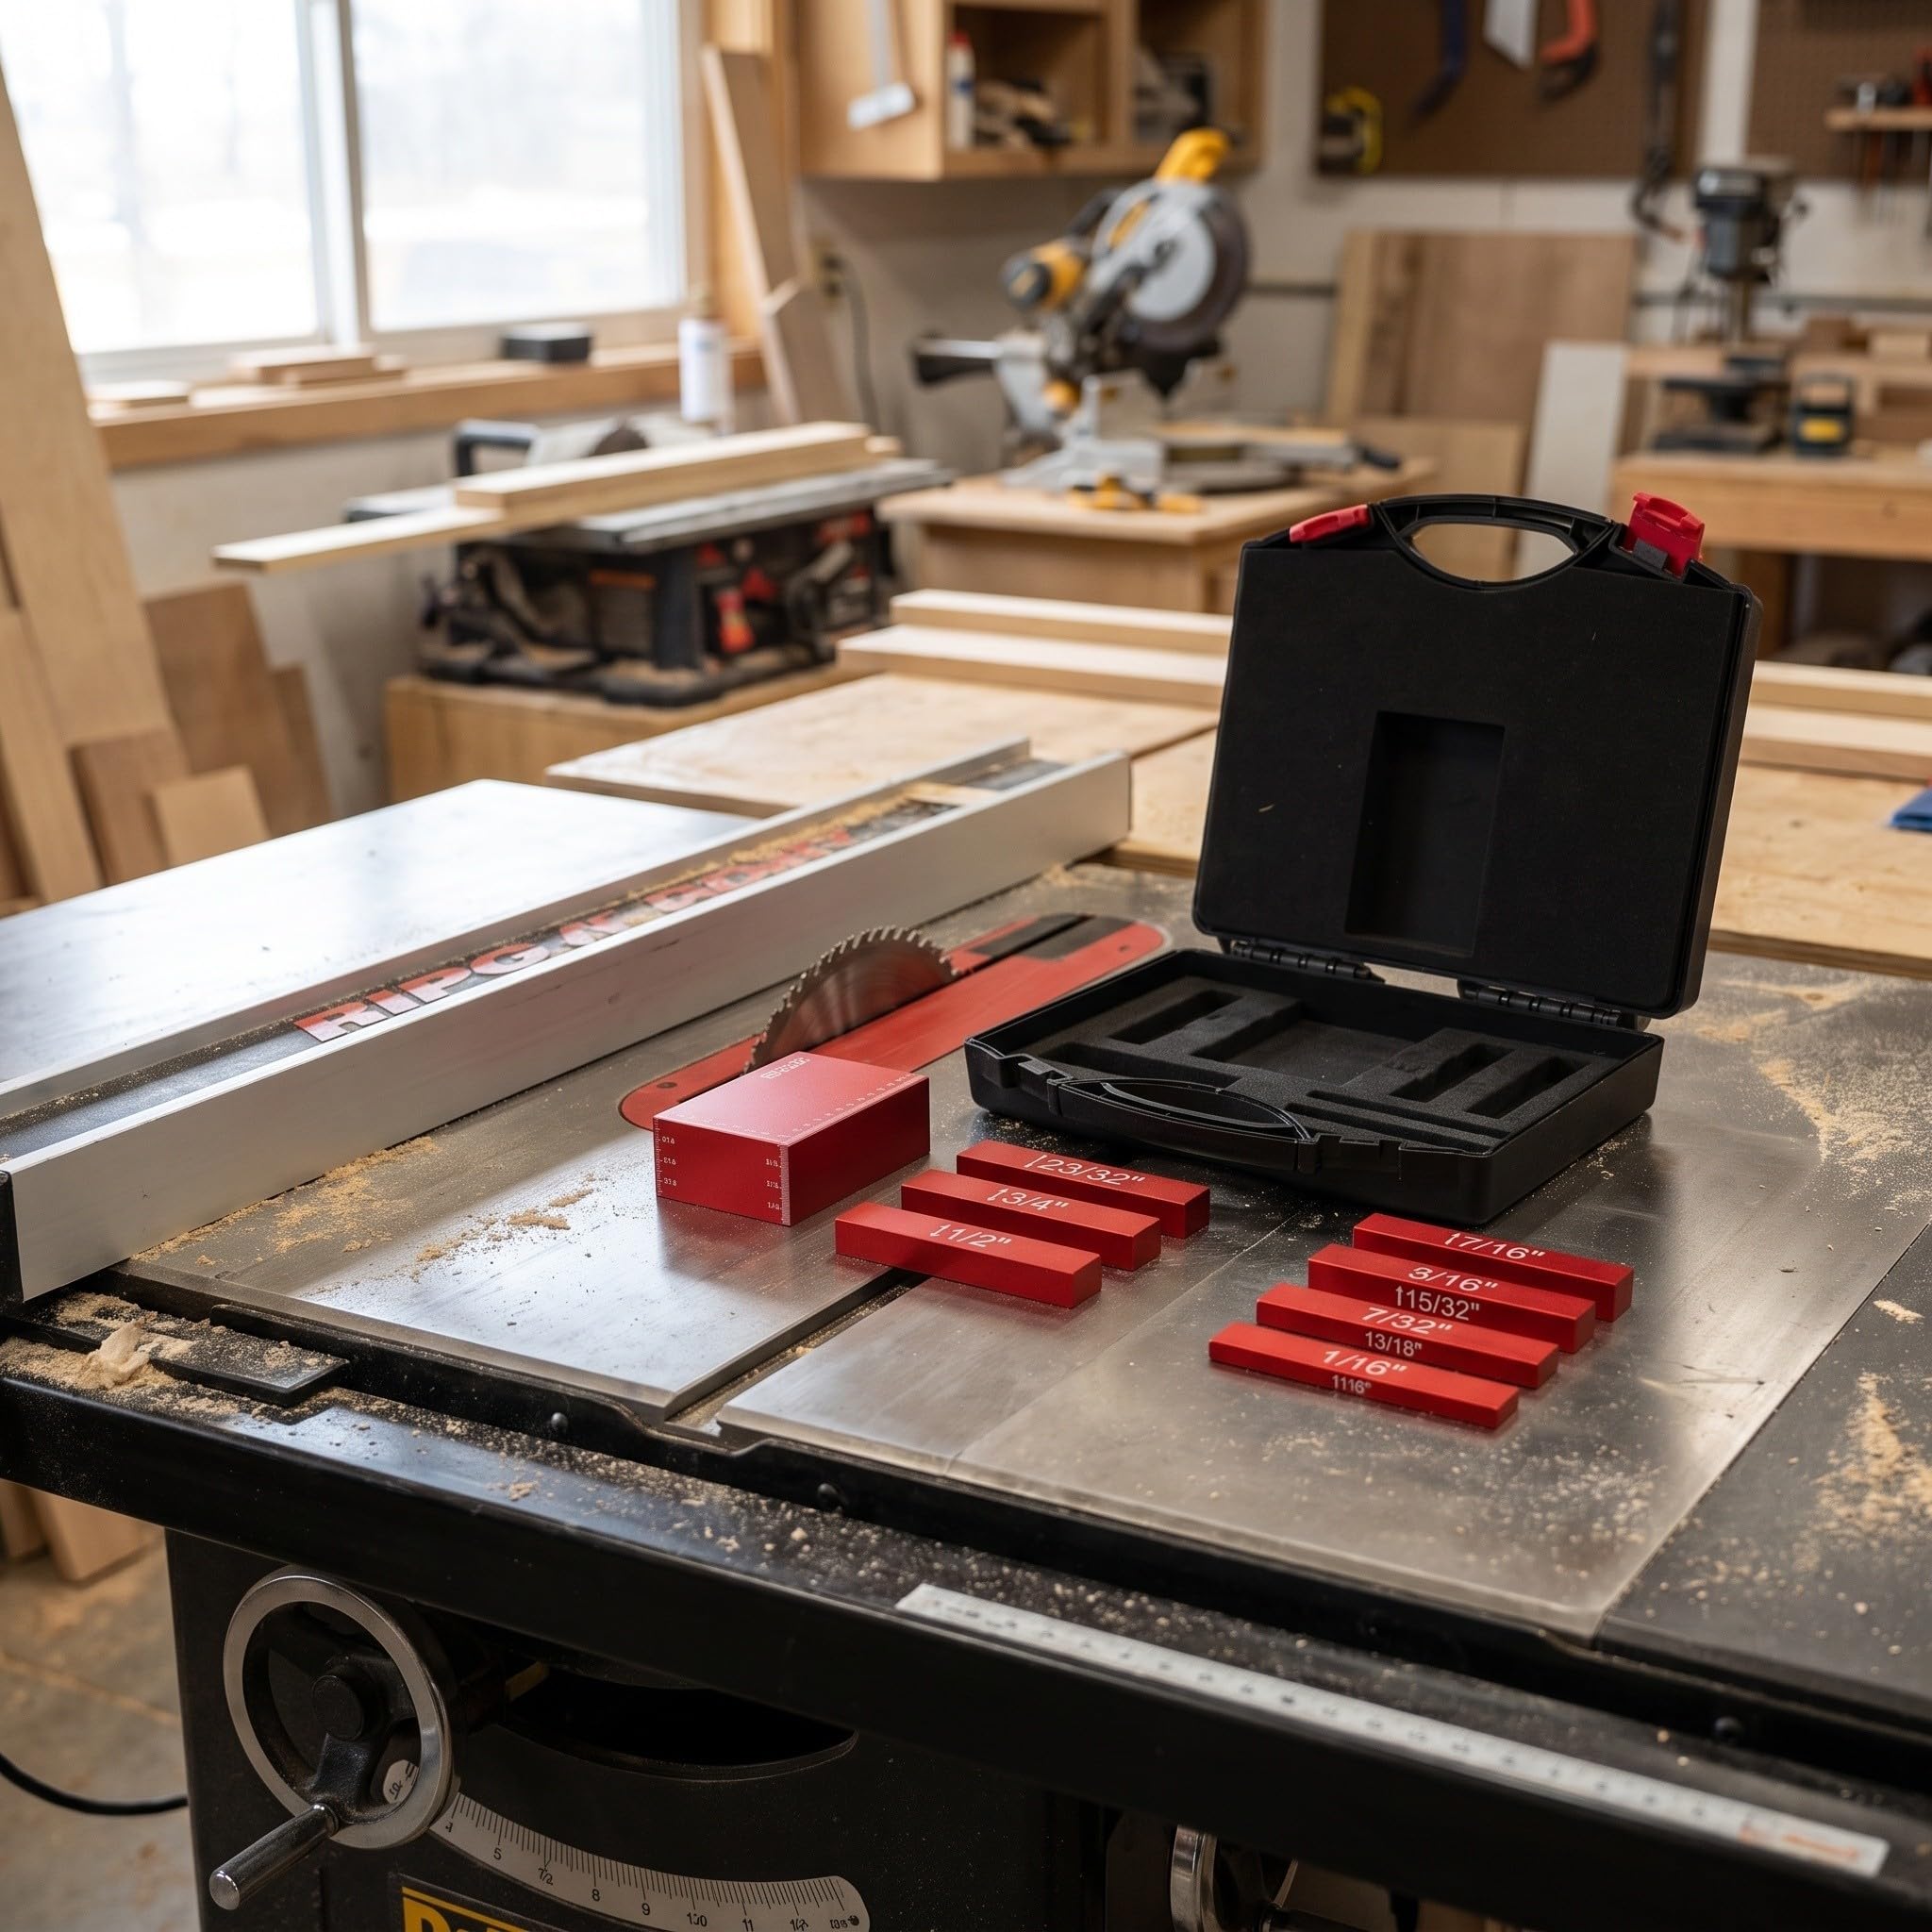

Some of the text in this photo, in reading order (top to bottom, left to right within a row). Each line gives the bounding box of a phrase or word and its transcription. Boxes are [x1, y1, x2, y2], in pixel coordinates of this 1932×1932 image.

[1407, 1267, 1499, 1291] 3/16"
[1361, 1307, 1453, 1335] 7/32"
[1323, 1350, 1408, 1376] 1/16"
[492, 1847, 503, 1860] 5
[591, 1889, 600, 1902] 8
[641, 1903, 651, 1916] 9
[741, 1919, 754, 1932] 11
